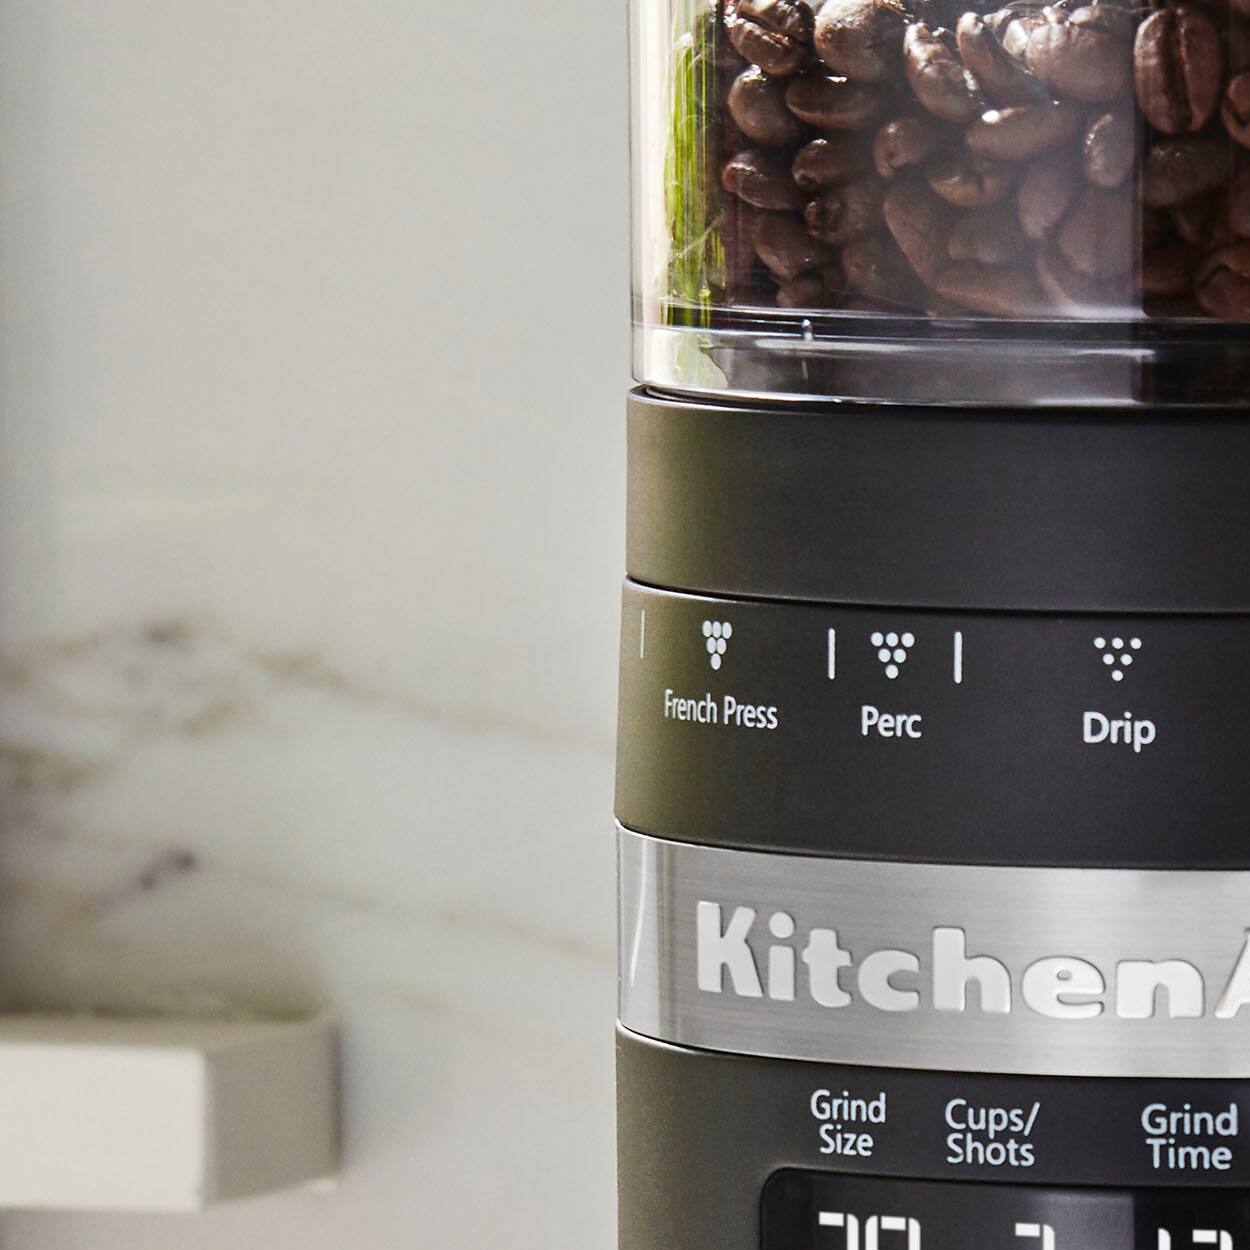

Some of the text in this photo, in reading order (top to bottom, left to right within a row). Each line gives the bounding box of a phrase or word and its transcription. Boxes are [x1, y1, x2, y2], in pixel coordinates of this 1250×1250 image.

[664, 689, 778, 730] French Press
[861, 706, 922, 739] Perc
[1083, 711, 1156, 752] Drip
[810, 1089, 886, 1124] Grind
[945, 1098, 1041, 1138] Cups/
[1141, 1103, 1238, 1136] Grind
[819, 1124, 874, 1157] Size
[946, 1132, 1035, 1167] Shots
[1146, 1138, 1233, 1170] Time
